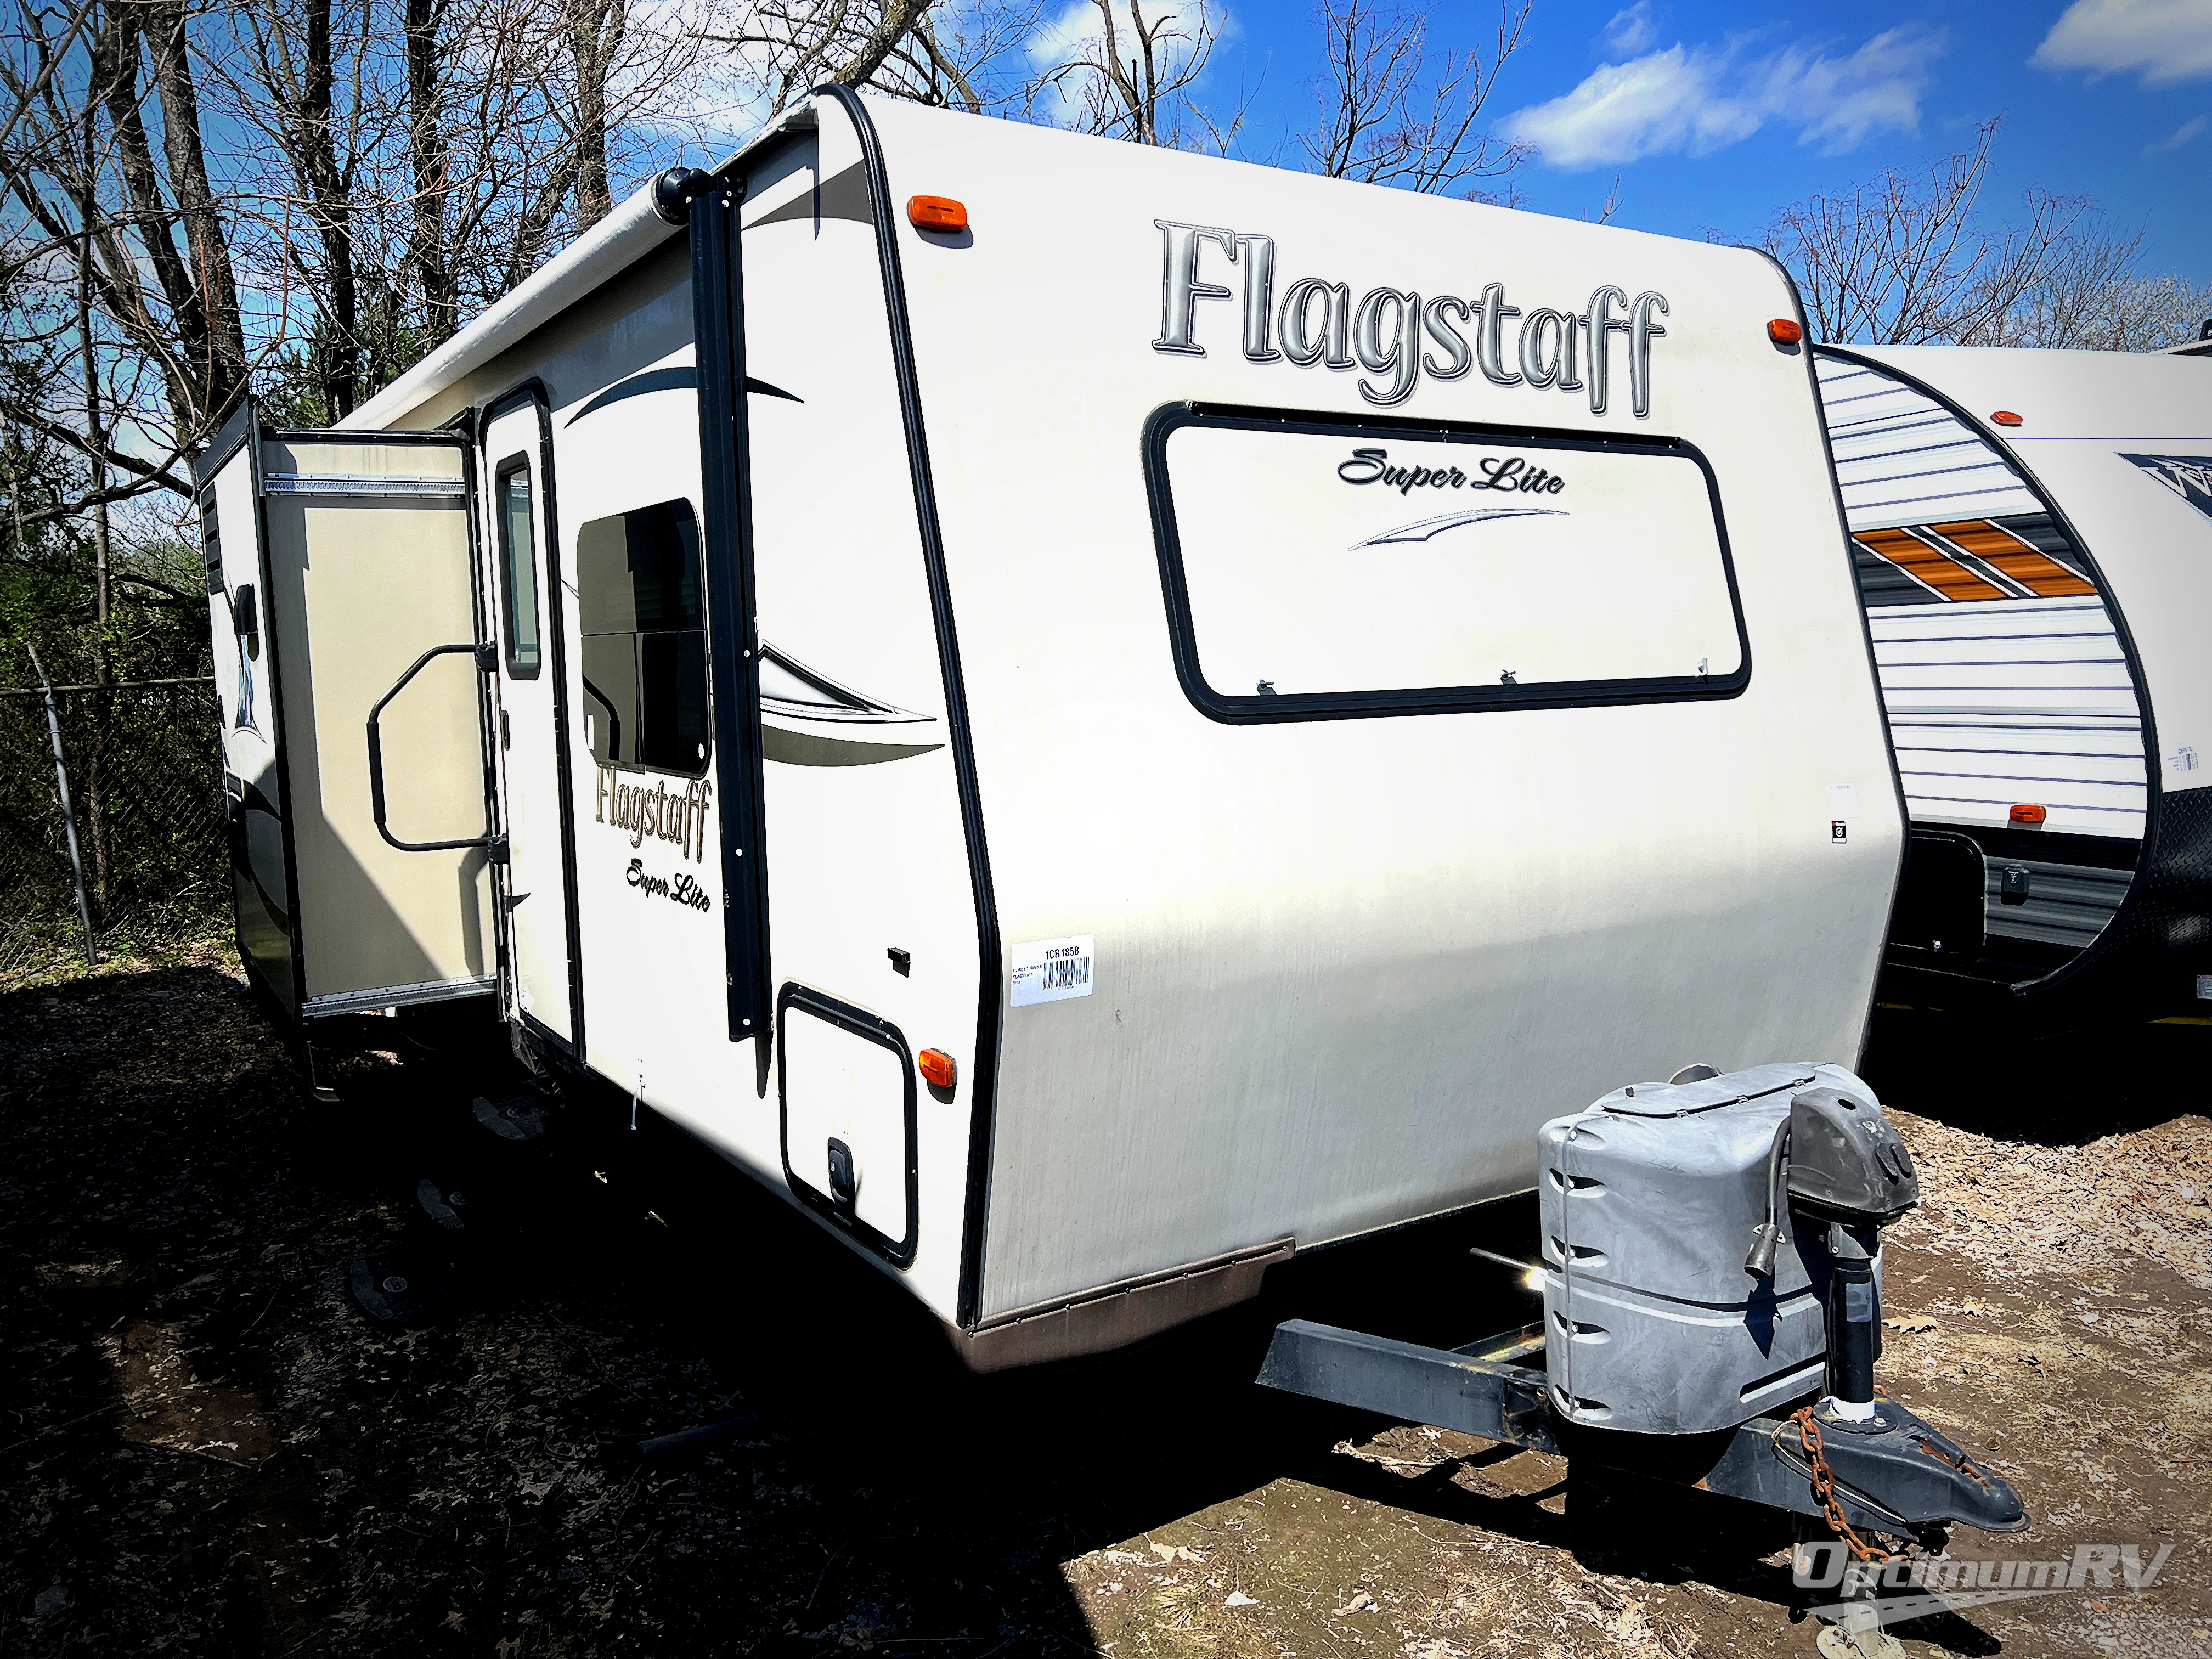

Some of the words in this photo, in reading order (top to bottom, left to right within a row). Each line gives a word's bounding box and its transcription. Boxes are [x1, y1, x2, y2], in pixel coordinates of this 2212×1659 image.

[1152, 219, 1670, 419] Flagstaff
[1338, 448, 1467, 495] Super
[1470, 456, 1565, 494] Lite
[595, 766, 712, 864] Flagstaff
[626, 857, 669, 898] Super
[670, 872, 711, 913] Lite
[1045, 946, 1080, 960] 1CR185B
